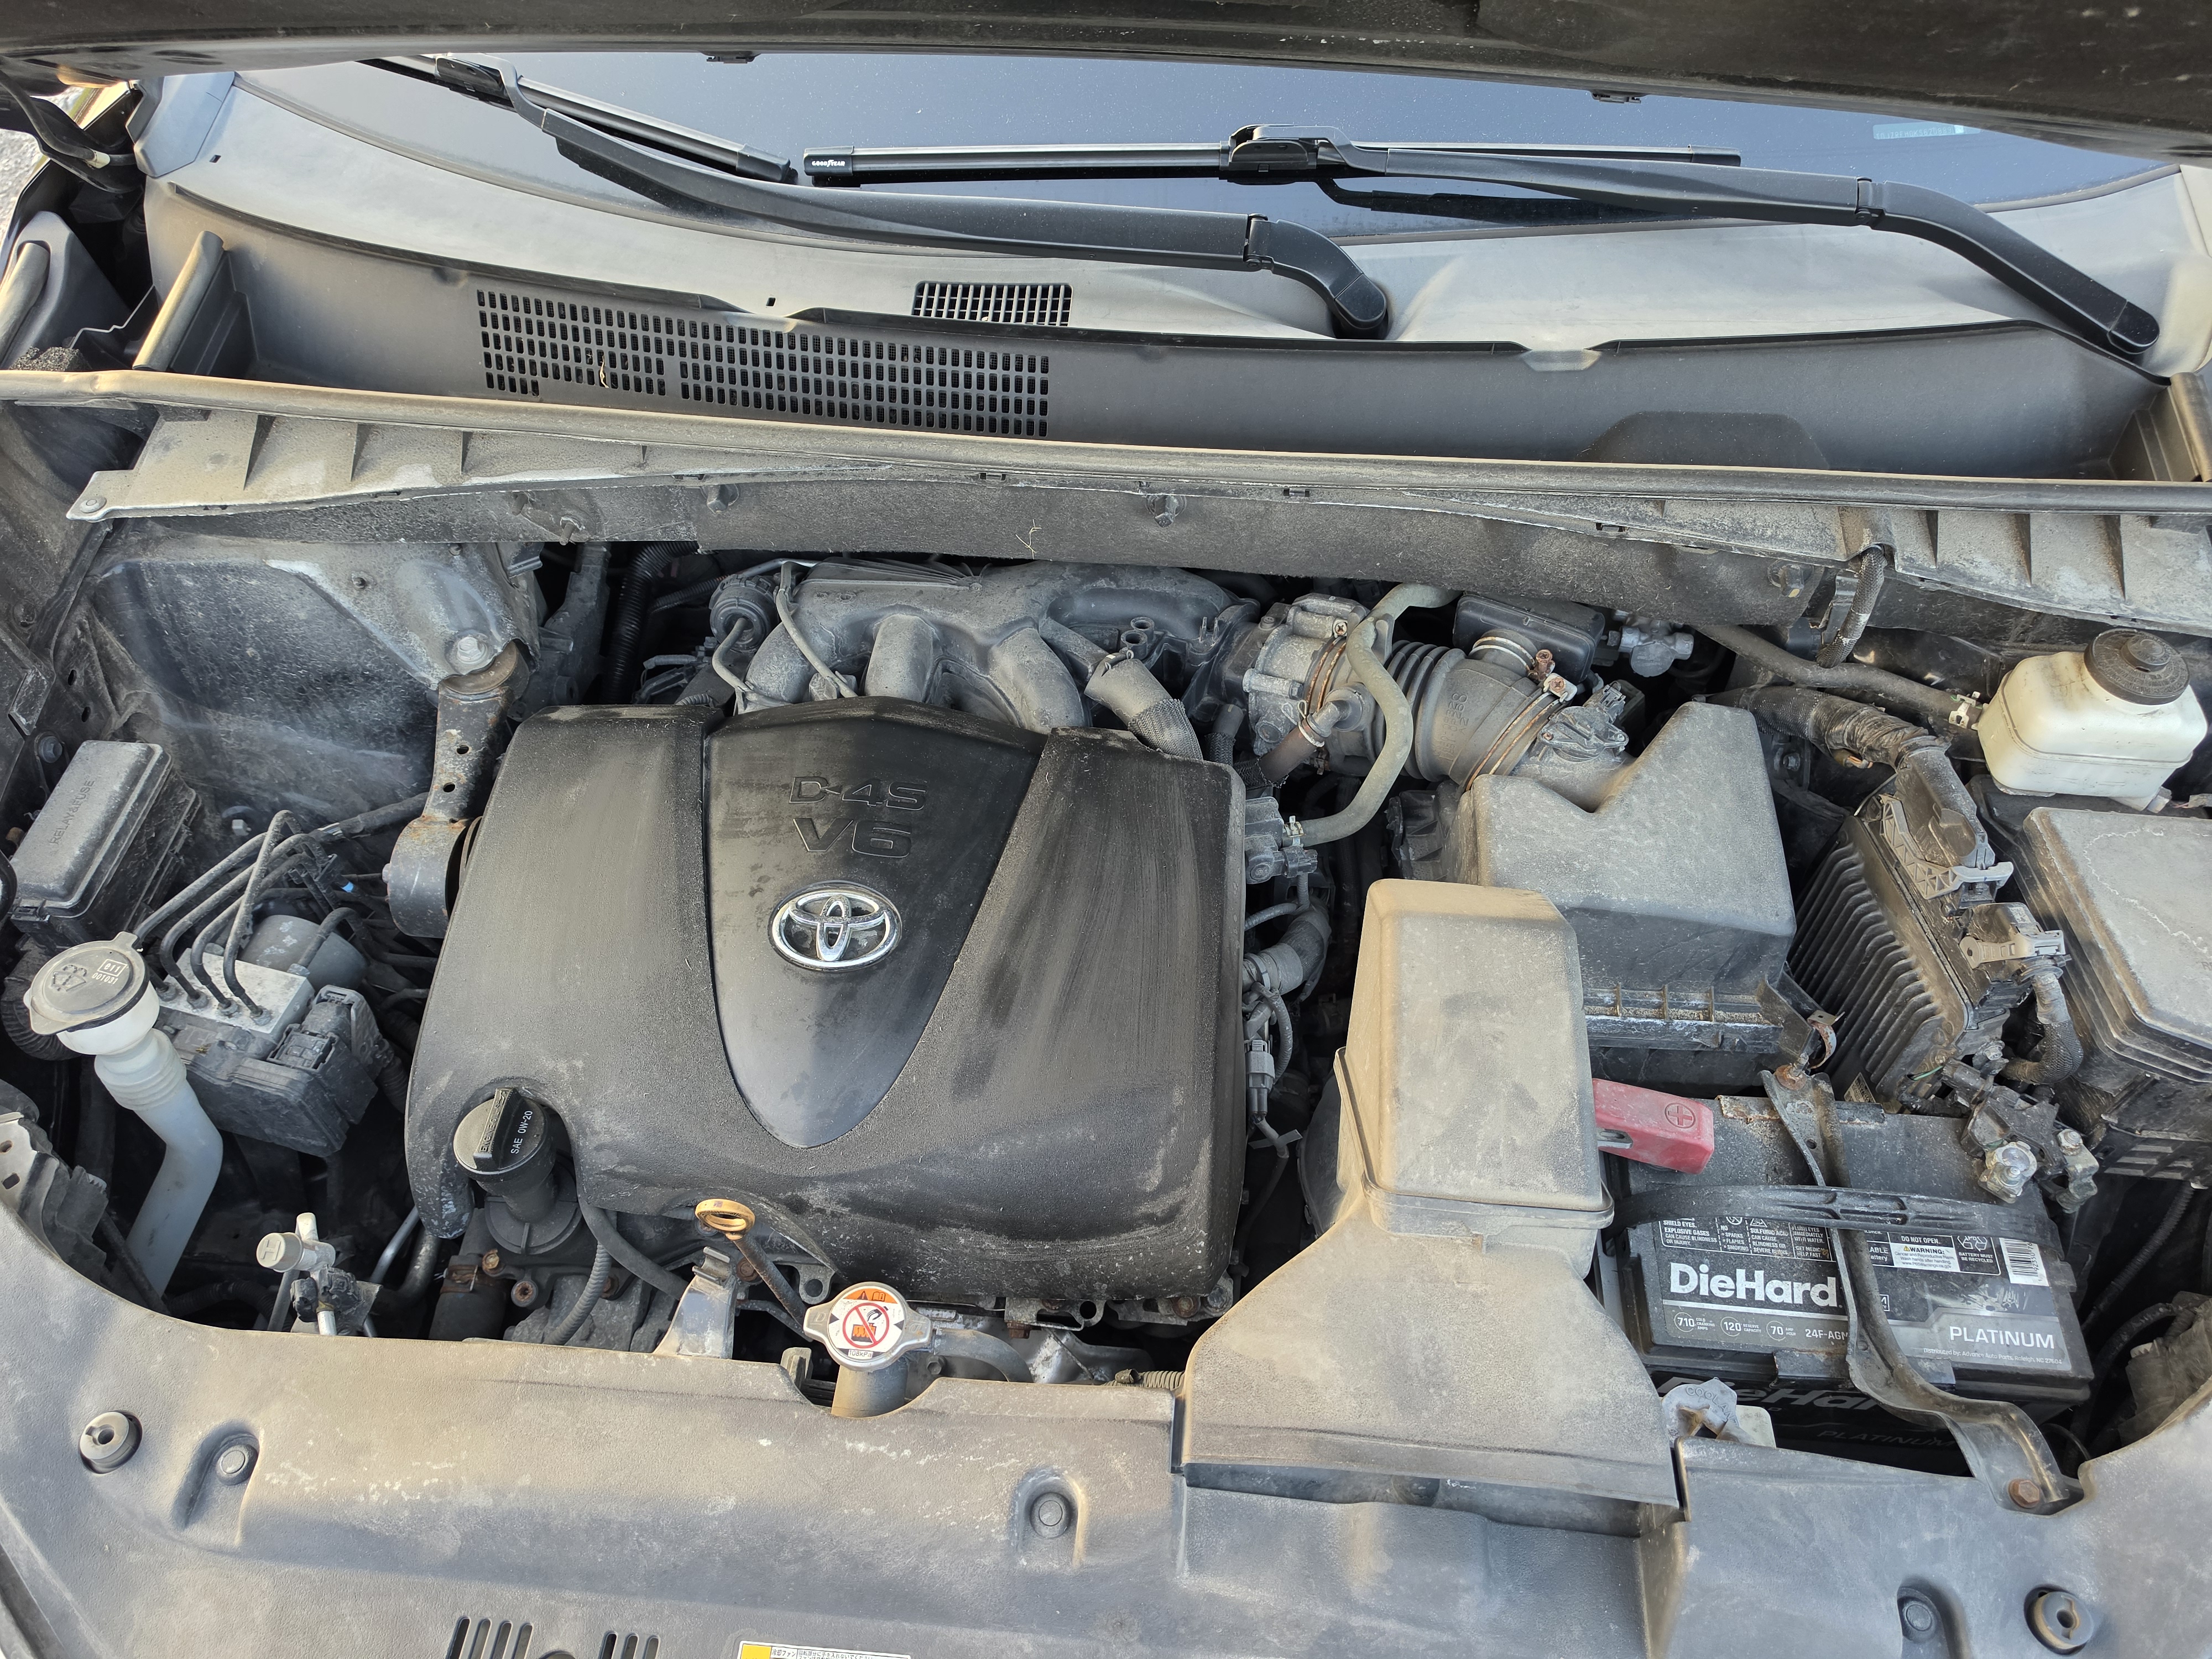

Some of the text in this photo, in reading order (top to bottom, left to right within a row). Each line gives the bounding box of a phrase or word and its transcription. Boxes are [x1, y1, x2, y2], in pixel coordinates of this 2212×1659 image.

[789, 776, 926, 811] D-4S
[793, 818, 911, 858] V6
[103, 963, 121, 973] e11
[92, 972, 118, 984] 001031
[510, 1110, 533, 1154] SAE 0W-20
[260, 1239, 281, 1261] H
[1670, 1262, 1838, 1307] DieHard
[1677, 1317, 1695, 1327] 710
[1724, 1321, 1741, 1332] 120
[1770, 1326, 1783, 1335] 70
[1949, 1326, 2055, 1349] PLATINUM
[849, 1349, 872, 1358] 108kPa
[1817, 1431, 1955, 1447] PLATINUM
